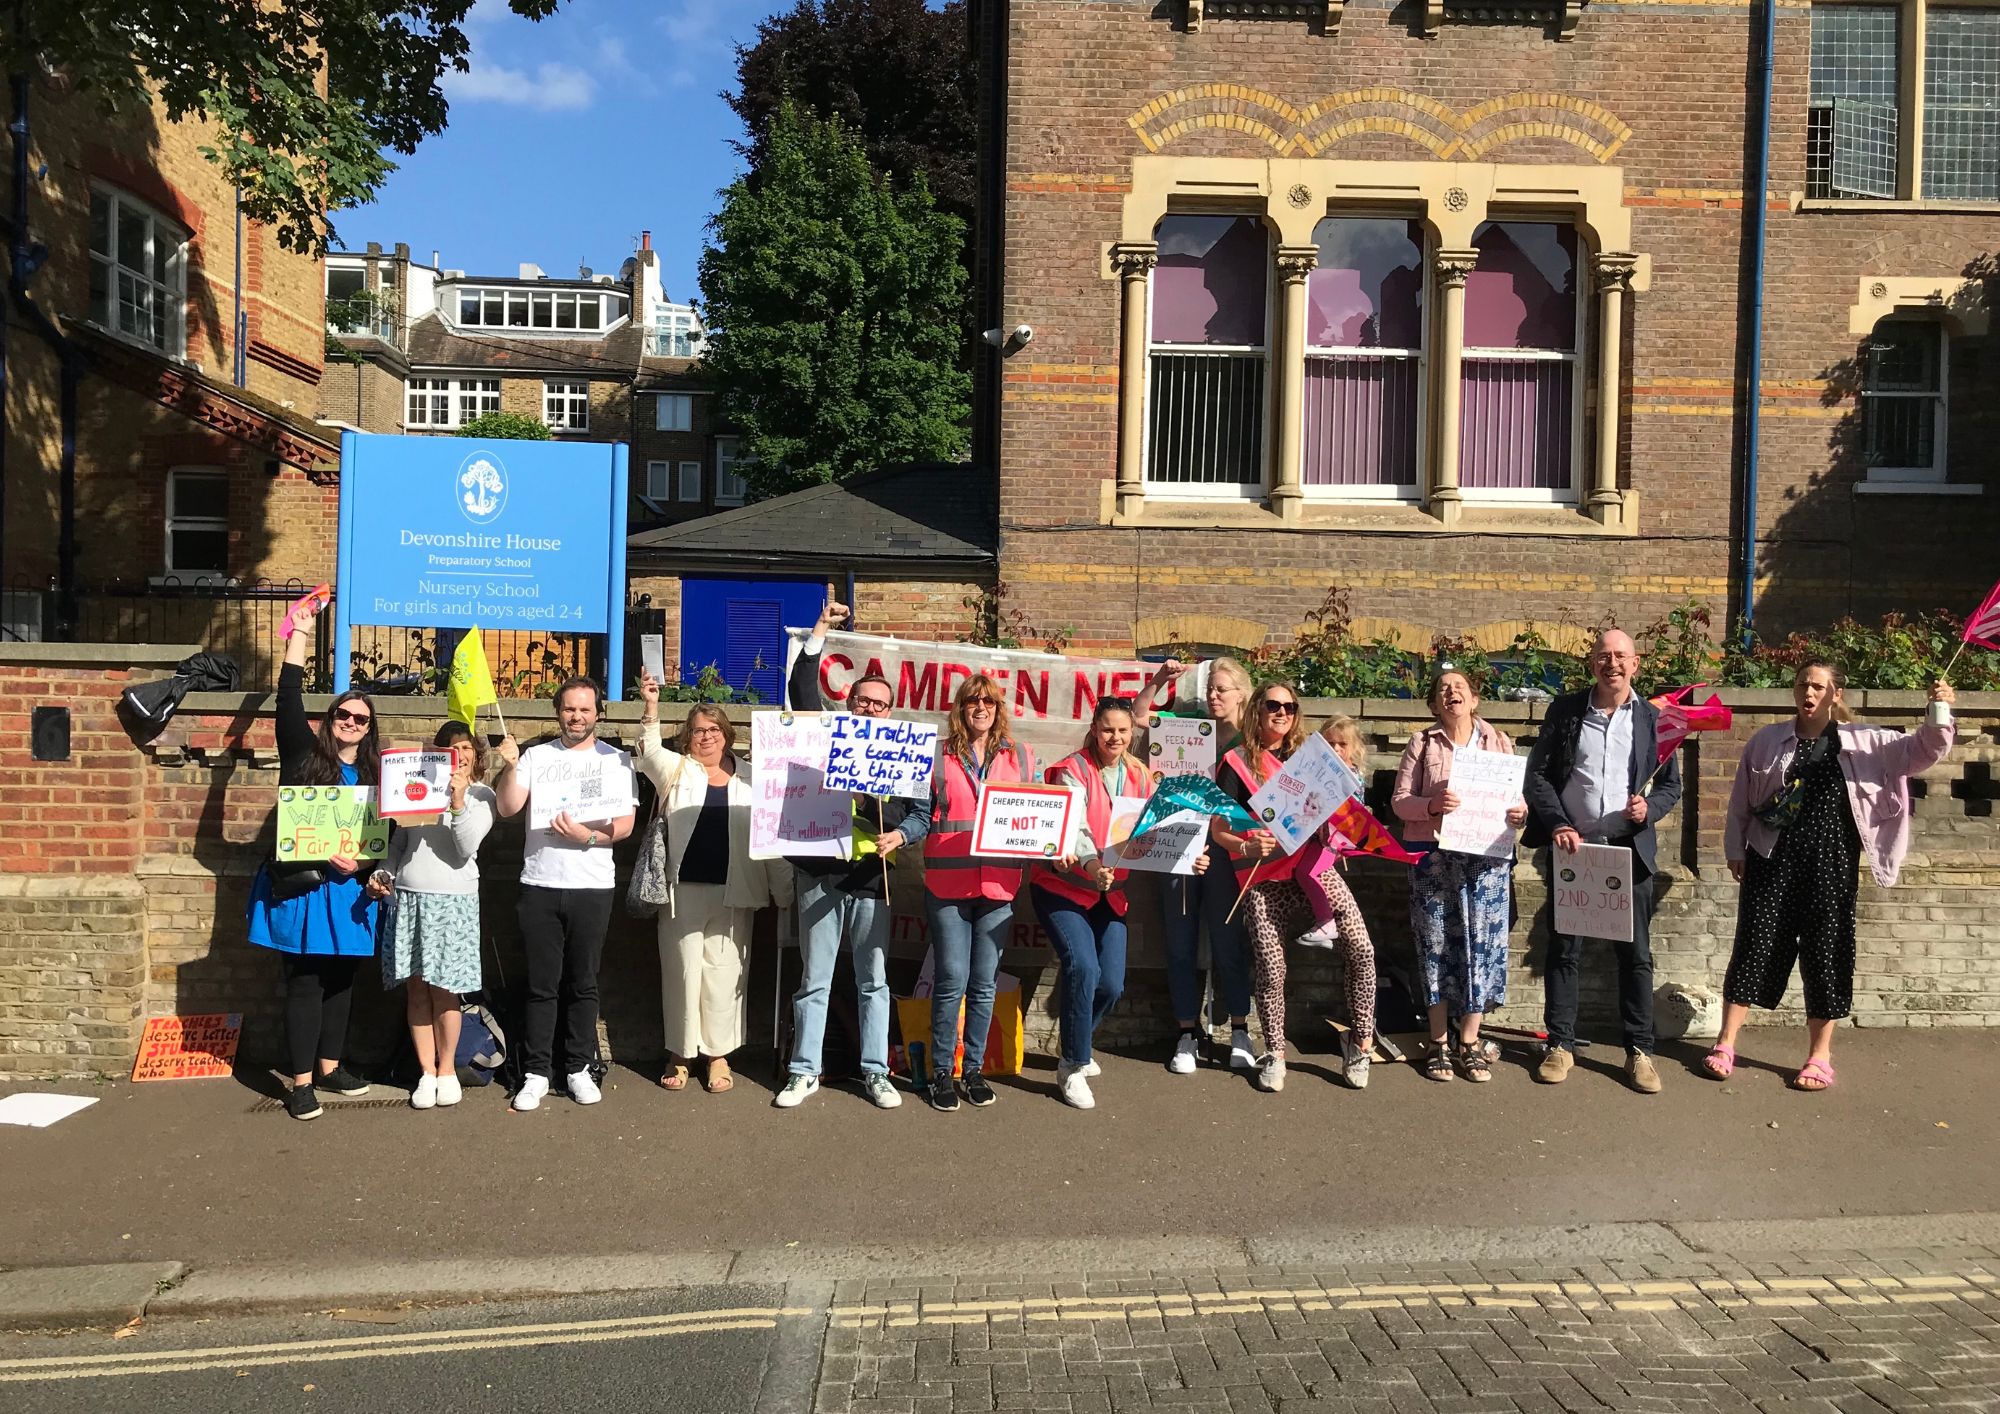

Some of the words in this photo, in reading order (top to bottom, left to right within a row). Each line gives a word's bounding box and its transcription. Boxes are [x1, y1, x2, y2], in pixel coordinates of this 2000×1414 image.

[400, 530, 501, 550] Devonshire
[506, 534, 561, 551] House
[428, 554, 492, 568] Preparatory
[494, 556, 531, 568] School
[418, 580, 481, 599] Nursery
[486, 582, 539, 598] School
[374, 599, 400, 613] For
[404, 599, 438, 617] girls
[442, 600, 472, 615] and
[477, 600, 513, 619] boys
[518, 604, 554, 621] aged
[559, 605, 583, 619] 2-4
[1072, 671, 1176, 719] NEU
[831, 716, 871, 740] I'd
[875, 722, 937, 746] rather
[1165, 735, 1185, 745] FEES
[385, 757, 406, 765] MAKE
[829, 741, 854, 760] be
[865, 744, 933, 774] teaching
[1454, 748, 1477, 764] End
[537, 762, 572, 783] 2018
[575, 761, 603, 779] called
[827, 759, 861, 776] but
[869, 761, 903, 780] this
[912, 767, 926, 782] is
[1157, 760, 1199, 770] INFLATION
[764, 779, 804, 801] there
[993, 797, 1025, 807] CHEAPER
[1027, 800, 1063, 809] TEACHERS
[1165, 784, 1219, 814] national
[287, 805, 328, 826] WE
[994, 817, 1008, 825] ARE
[1011, 816, 1038, 831] NOT
[1041, 820, 1055, 828] THE
[752, 808, 795, 848] £34
[295, 828, 330, 858] Fair
[338, 829, 368, 859] Pay
[1005, 838, 1038, 847] ANSWER!
[1148, 838, 1177, 847] SHALL
[1132, 848, 1162, 859] KNOW
[1165, 851, 1190, 860] THEM
[1583, 868, 1593, 882] A
[1558, 889, 1590, 907] 2ND
[1597, 893, 1630, 910] JOB
[146, 1029, 197, 1042] deserve
[147, 1042, 230, 1057] STUDENTS
[140, 1057, 186, 1069] deserve
[139, 1069, 165, 1078] who
